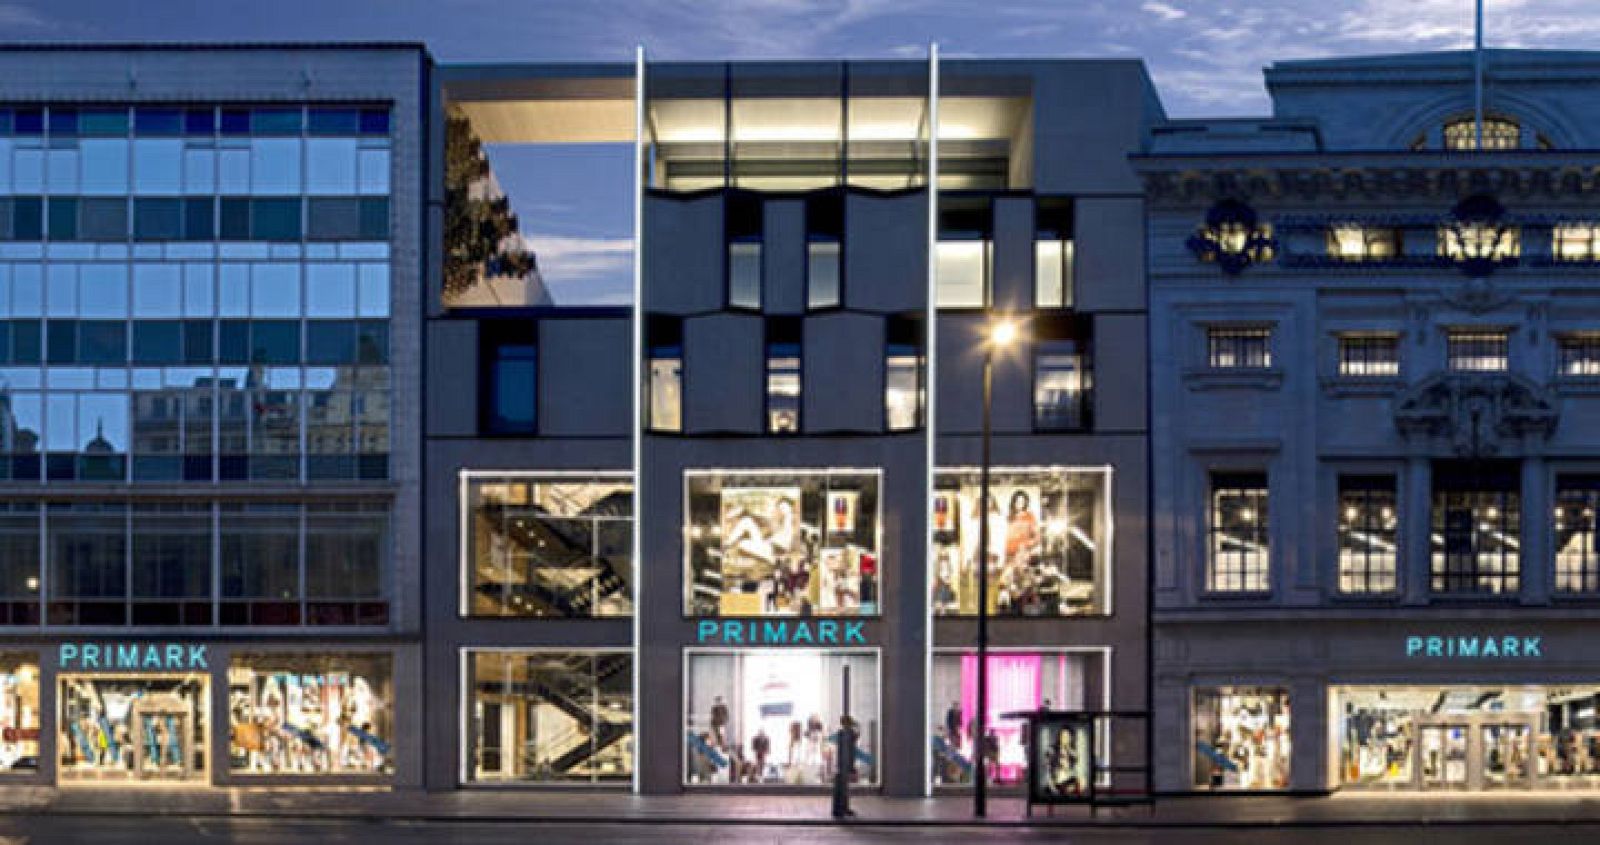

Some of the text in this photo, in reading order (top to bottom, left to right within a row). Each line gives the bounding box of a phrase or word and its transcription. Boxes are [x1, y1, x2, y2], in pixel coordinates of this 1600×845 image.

[698, 620, 866, 643] PRIMARK
[60, 644, 208, 668] PRIMARK
[1407, 636, 1541, 656] PRIMARK
